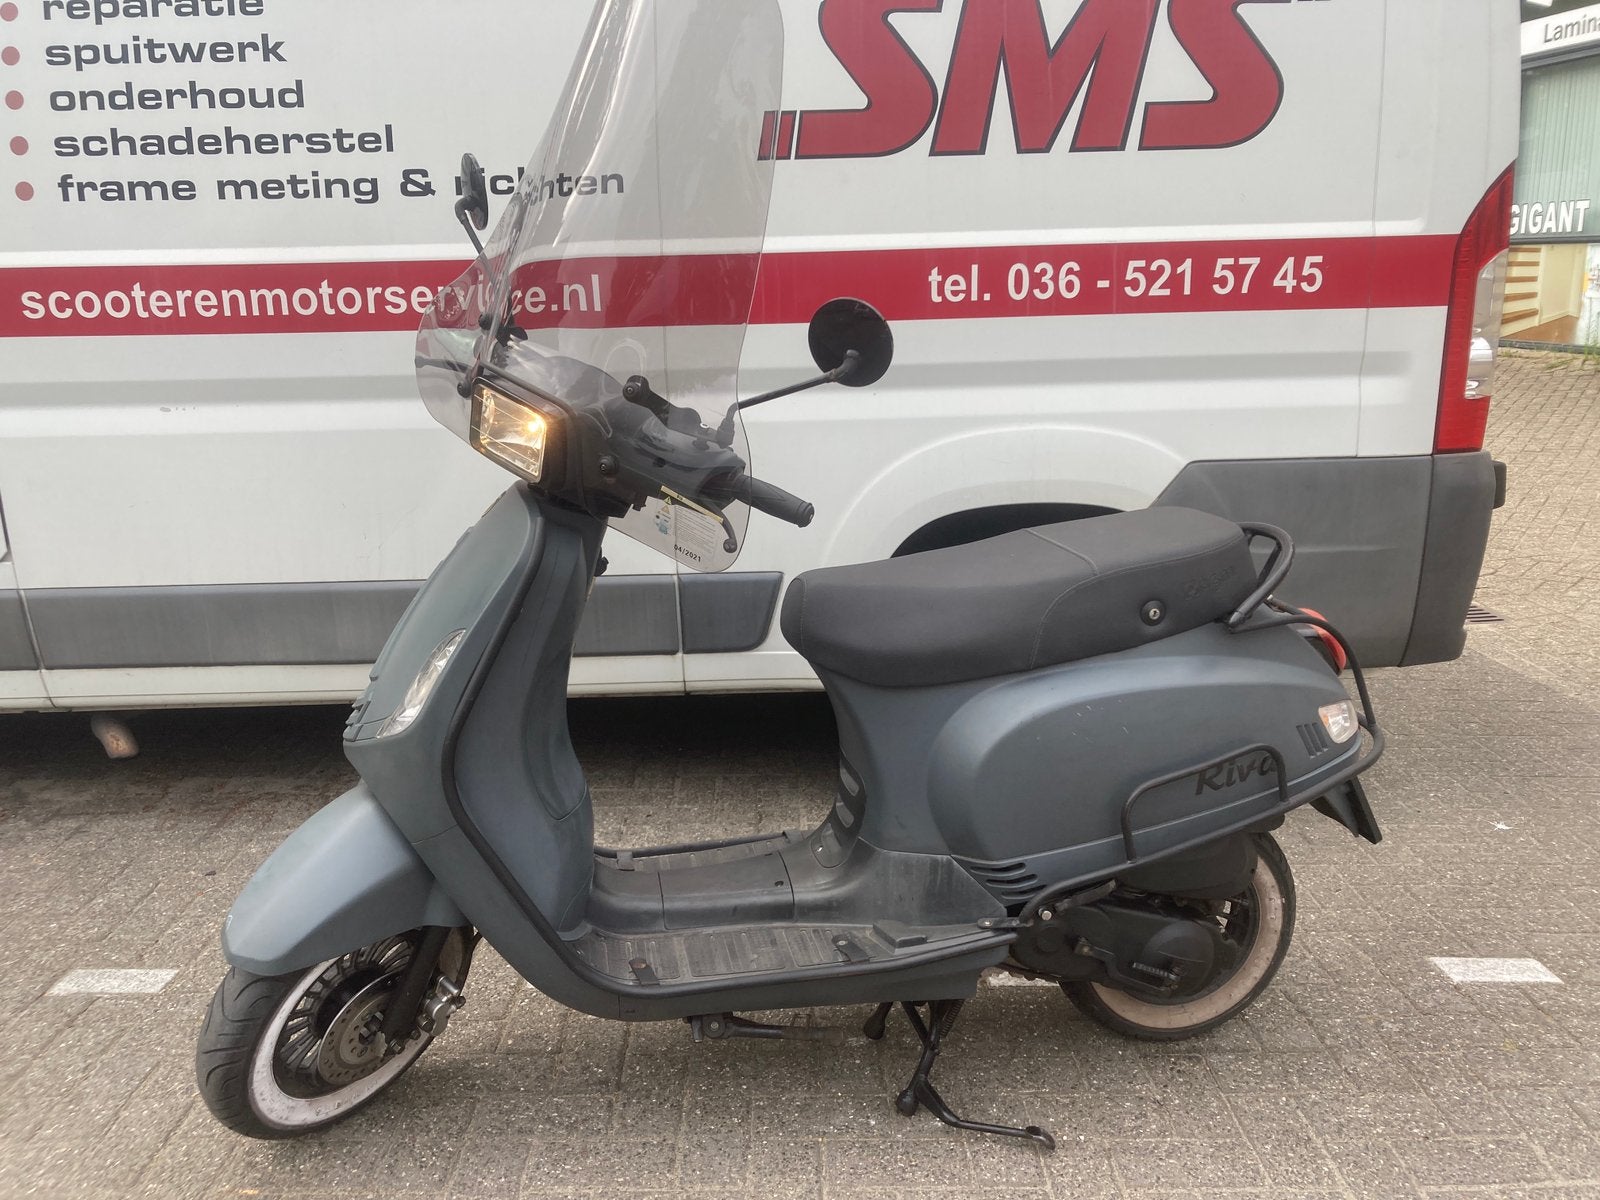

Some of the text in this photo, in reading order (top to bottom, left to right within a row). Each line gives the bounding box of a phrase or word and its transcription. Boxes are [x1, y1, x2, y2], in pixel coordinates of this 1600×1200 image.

[43, 0, 264, 25] reparatie
[1543, 14, 1600, 43] Lamin
[45, 33, 287, 71] spuitwerk
[49, 79, 305, 112] onderhoud
[795, 0, 1290, 160] SMS
[53, 124, 394, 157] schadeherstel
[57, 173, 197, 203] frame
[217, 171, 380, 205] meting
[400, 168, 437, 197] &
[1509, 199, 1591, 236] GIGANT
[928, 266, 992, 303] tel.
[1006, 261, 1082, 301] 036
[1123, 258, 1193, 299] 521
[1212, 257, 1261, 295] 57
[1272, 255, 1325, 294] 45
[673, 543, 702, 563] 04/2021
[1194, 752, 1279, 796] Riva
